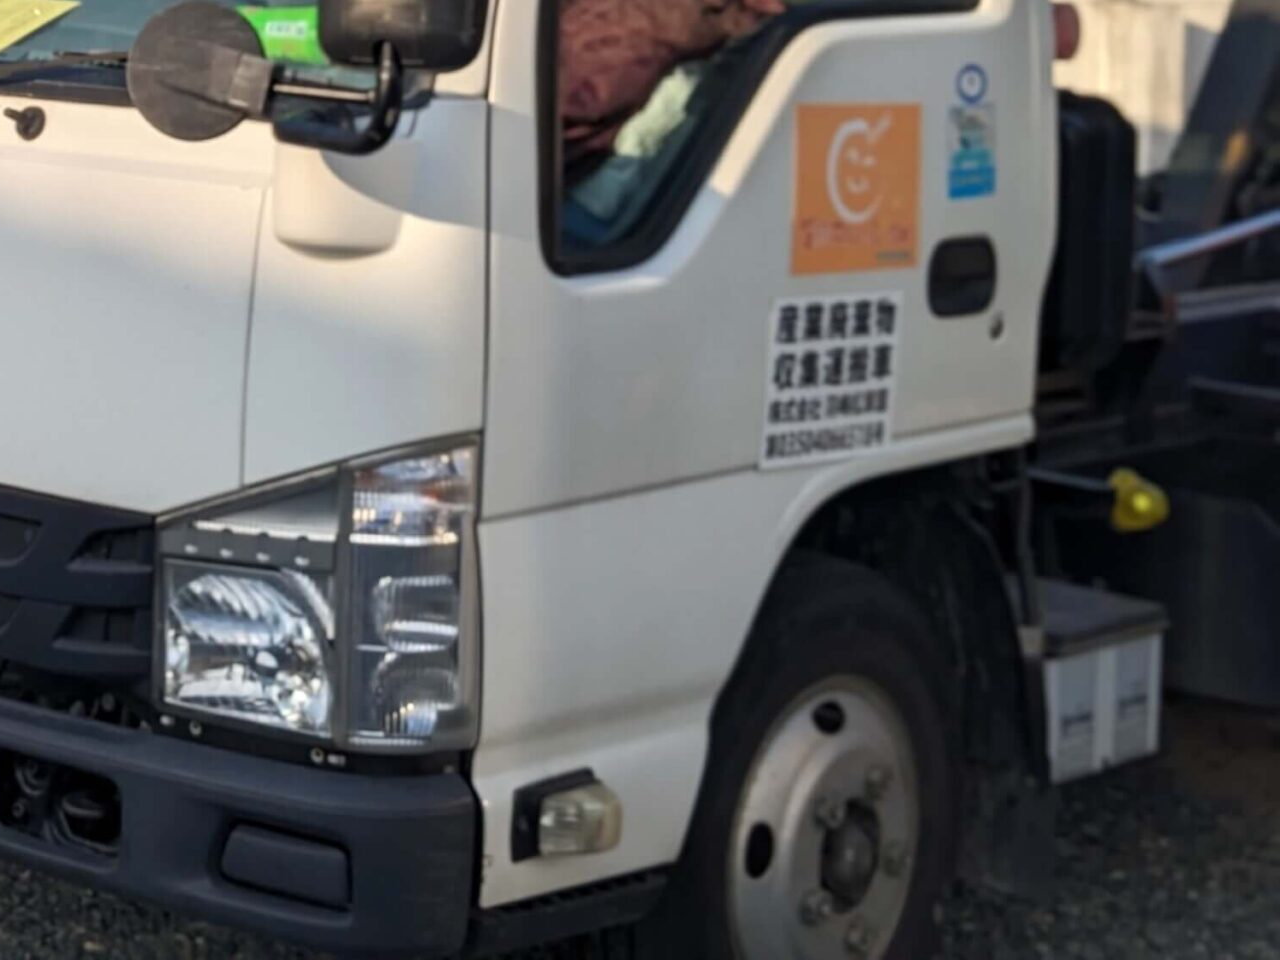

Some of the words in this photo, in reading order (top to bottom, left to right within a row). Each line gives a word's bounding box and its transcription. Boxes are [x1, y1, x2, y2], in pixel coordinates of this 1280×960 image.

[776, 298, 896, 343] 産業廃棄物
[774, 344, 892, 390] 収集運搬車
